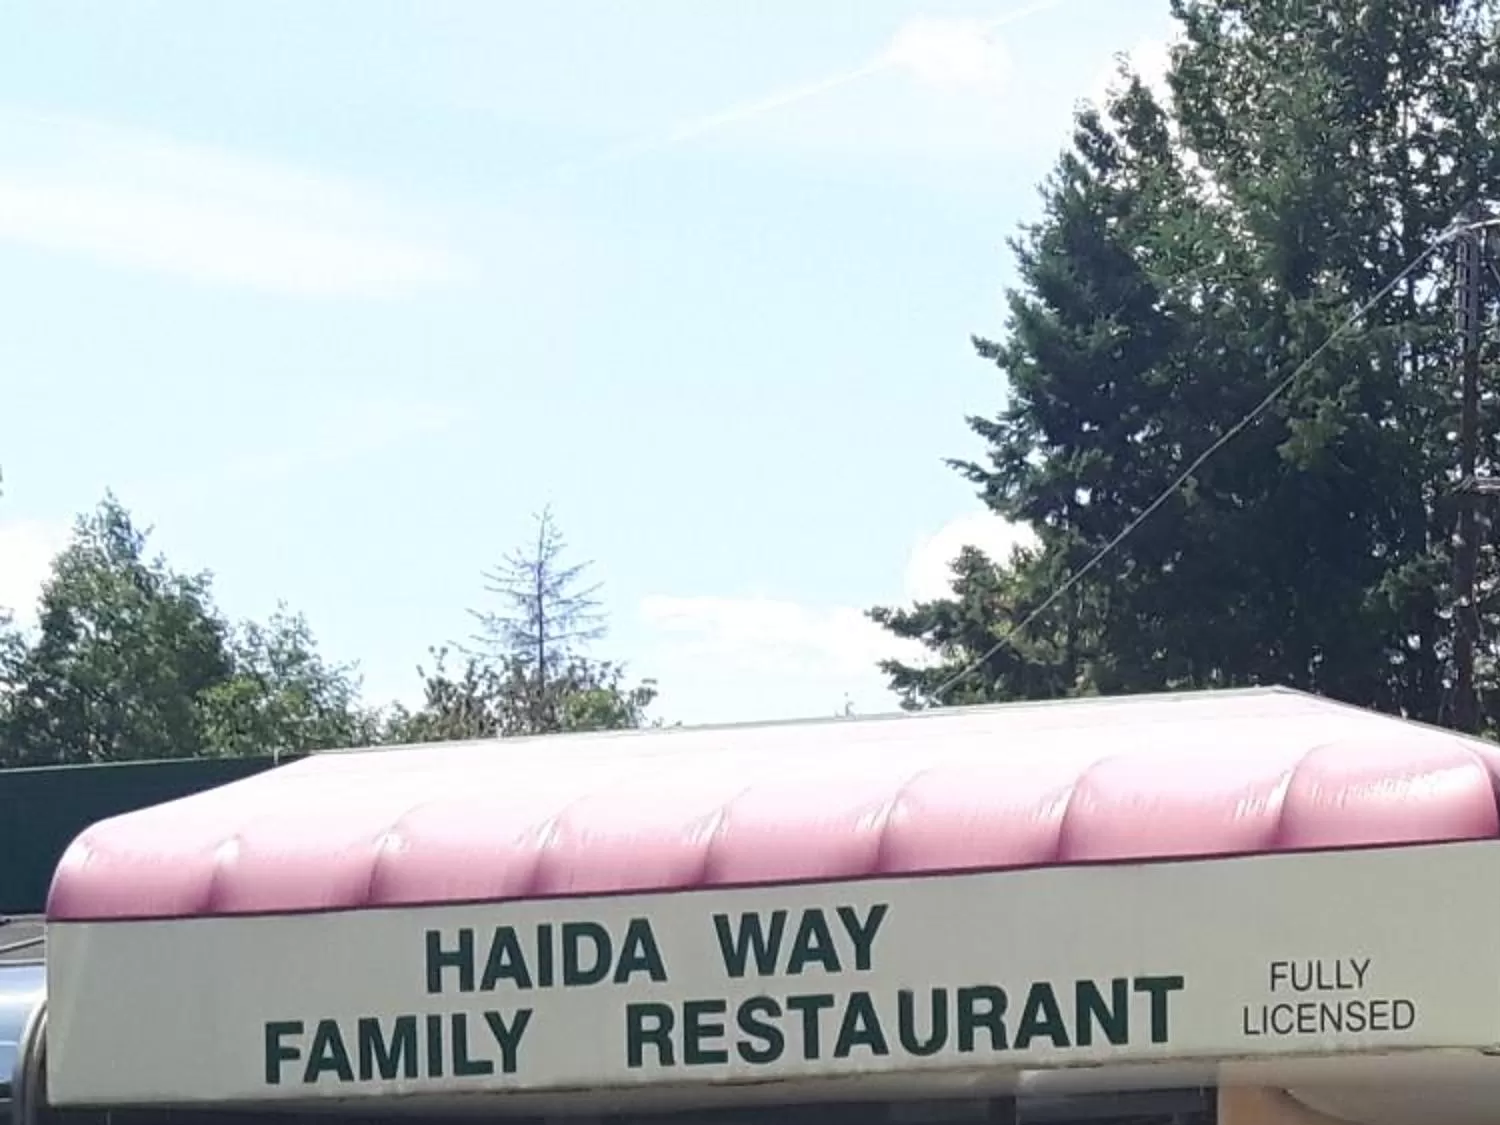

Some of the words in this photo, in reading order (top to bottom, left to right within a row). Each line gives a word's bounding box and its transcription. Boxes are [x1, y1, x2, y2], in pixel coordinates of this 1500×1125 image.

[424, 917, 667, 994] HAIDA
[713, 903, 889, 978] WAY
[1269, 958, 1372, 993] FULLY
[264, 1007, 534, 1084] FAMILY
[626, 975, 1185, 1068] RESTAURANT
[1242, 999, 1417, 1036] LICENSED
